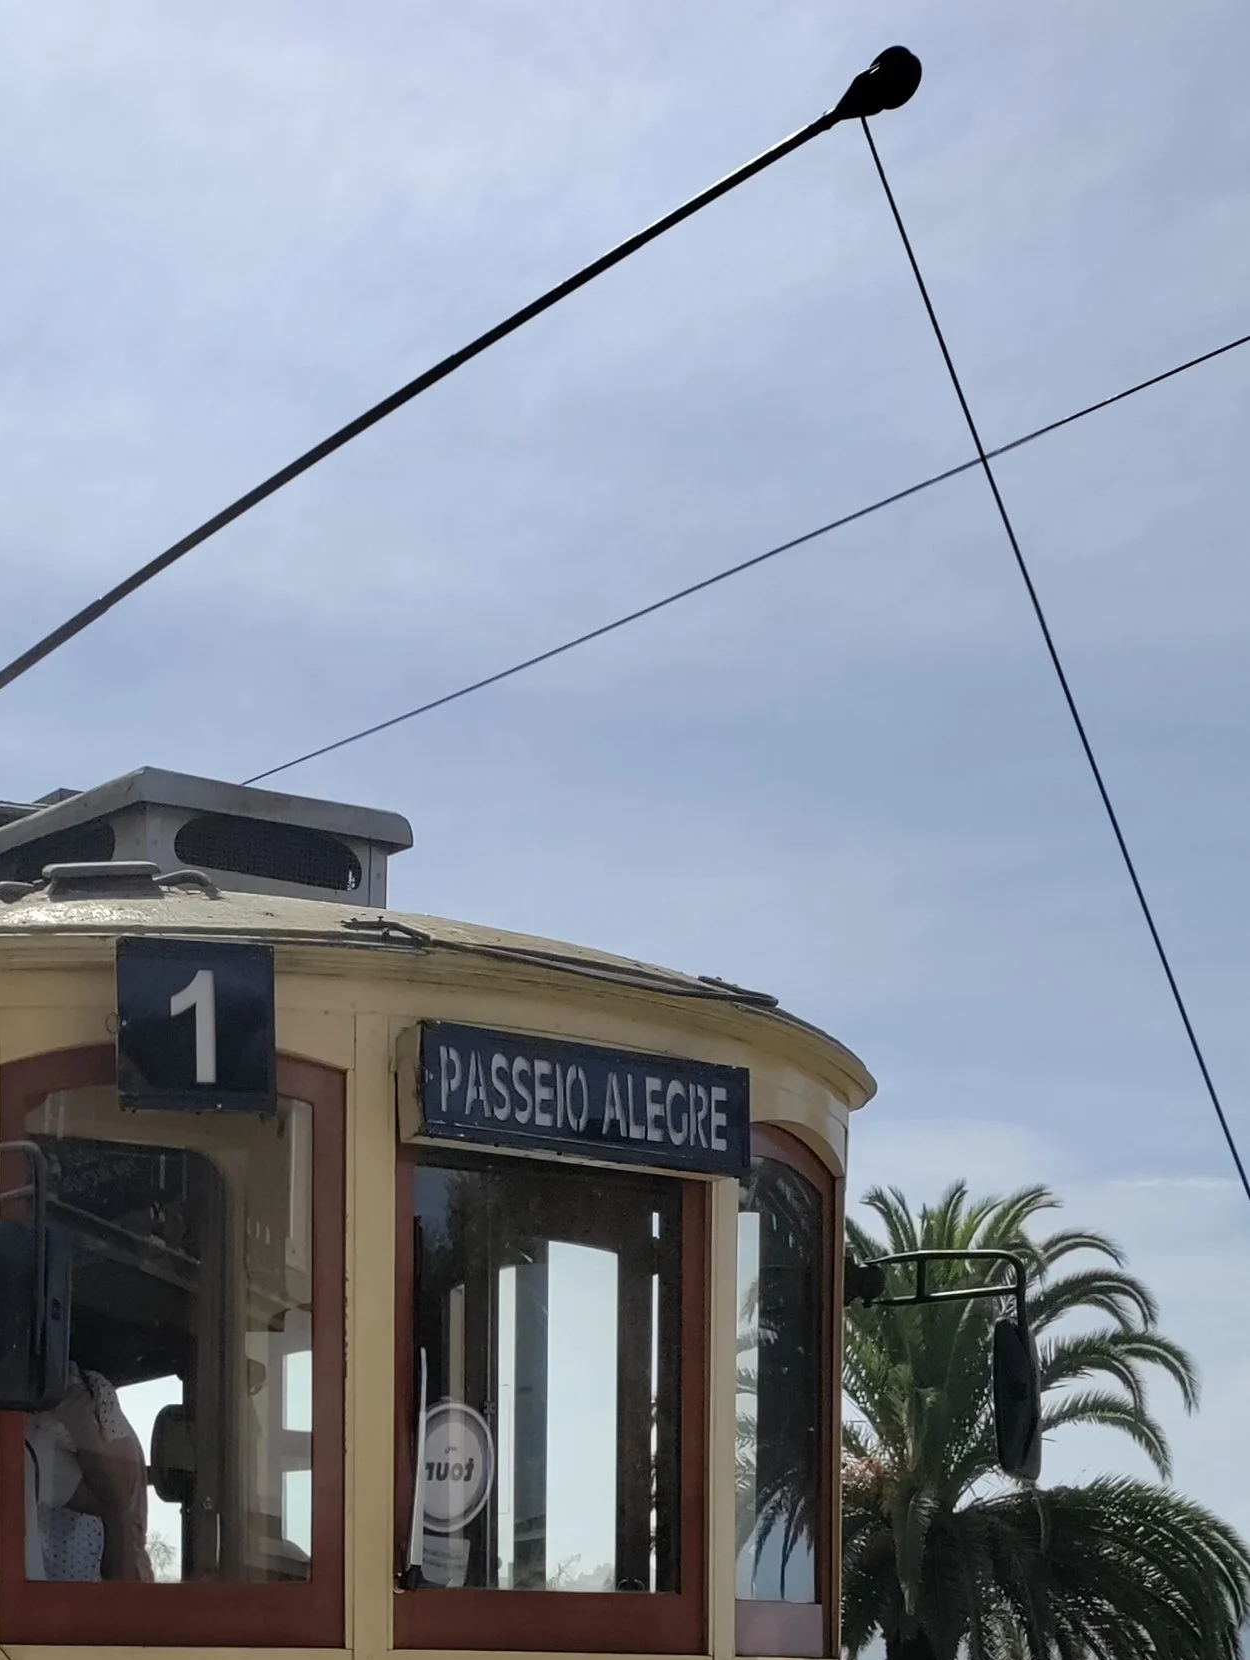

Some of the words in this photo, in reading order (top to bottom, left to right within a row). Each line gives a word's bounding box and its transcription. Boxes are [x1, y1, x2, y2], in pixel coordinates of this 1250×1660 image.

[170, 969, 217, 1084] 1
[438, 1044, 589, 1133] PASSEIO
[601, 1071, 728, 1151] ALEGRE
